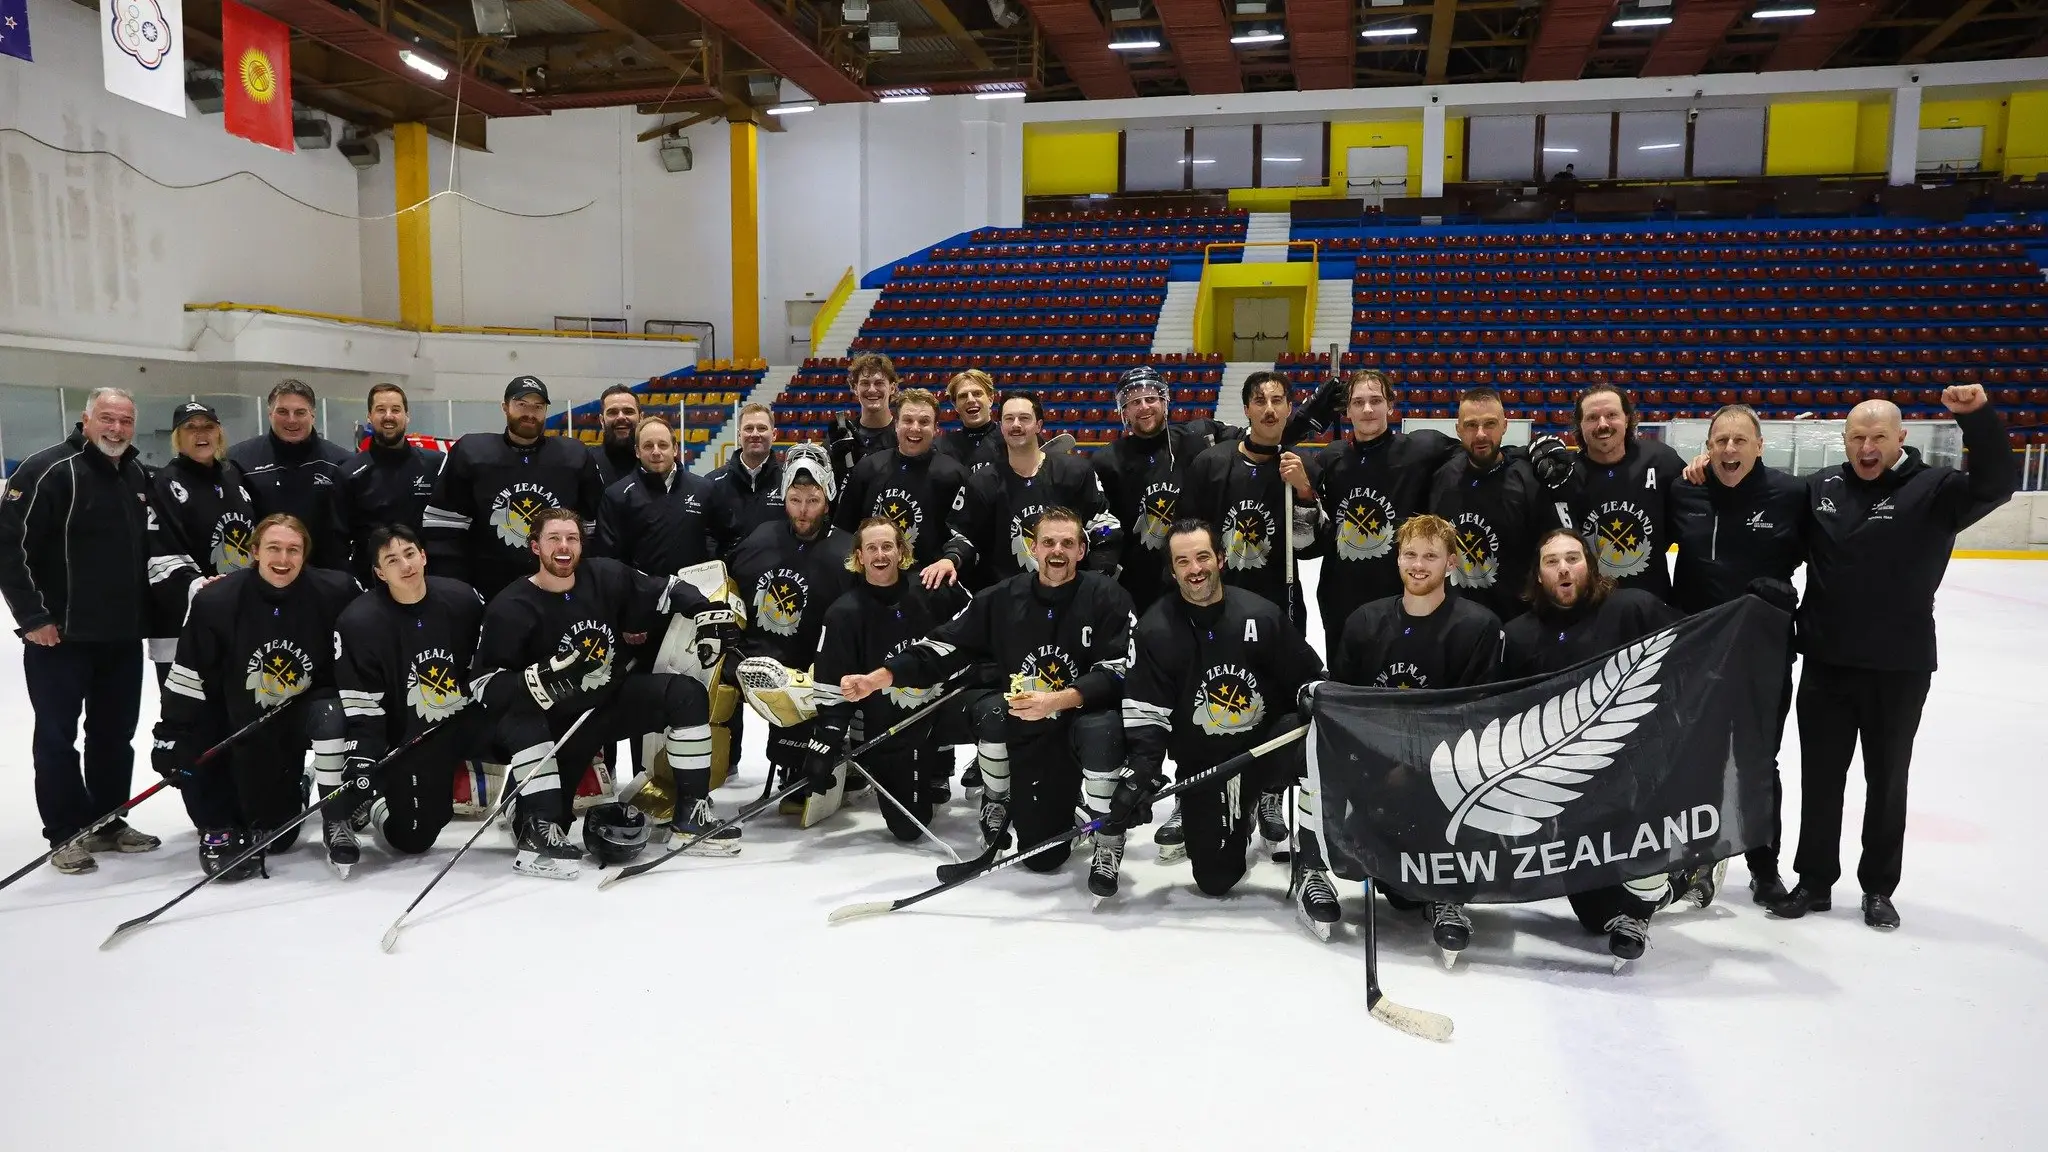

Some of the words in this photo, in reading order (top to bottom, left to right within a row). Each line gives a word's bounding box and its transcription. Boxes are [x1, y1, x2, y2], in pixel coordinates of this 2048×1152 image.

[1146, 482, 1181, 496] ZEALA
[1645, 468, 1657, 489] A
[492, 488, 512, 510] NEW
[513, 483, 560, 508] ZEALAN
[885, 488, 923, 523] ZEALAND
[952, 486, 966, 511] 6
[1222, 506, 1238, 532] NEW
[1336, 498, 1350, 524] NEW
[1601, 501, 1653, 536] ZEALAND
[211, 520, 225, 548] NEW
[221, 512, 254, 532] ZEALA
[1011, 515, 1022, 539] NEW
[1459, 513, 1499, 552] ZEALAND
[756, 570, 774, 590] NEW
[778, 568, 809, 607] ZEALA
[558, 633, 572, 652] EW
[571, 620, 615, 645] ZEALAND
[1082, 626, 1092, 647] C
[1244, 619, 1258, 641] A
[247, 648, 264, 673] NEW
[264, 640, 313, 671] ZEALAND
[416, 648, 455, 664] ZEALA
[1038, 644, 1079, 679] ZELAND
[1206, 664, 1257, 689] ZEALAND
[1389, 662, 1429, 688] ZEALA
[778, 738, 807, 749] BAUE
[1401, 849, 1497, 884] NEW
[1511, 804, 1720, 880] ZEALAND
